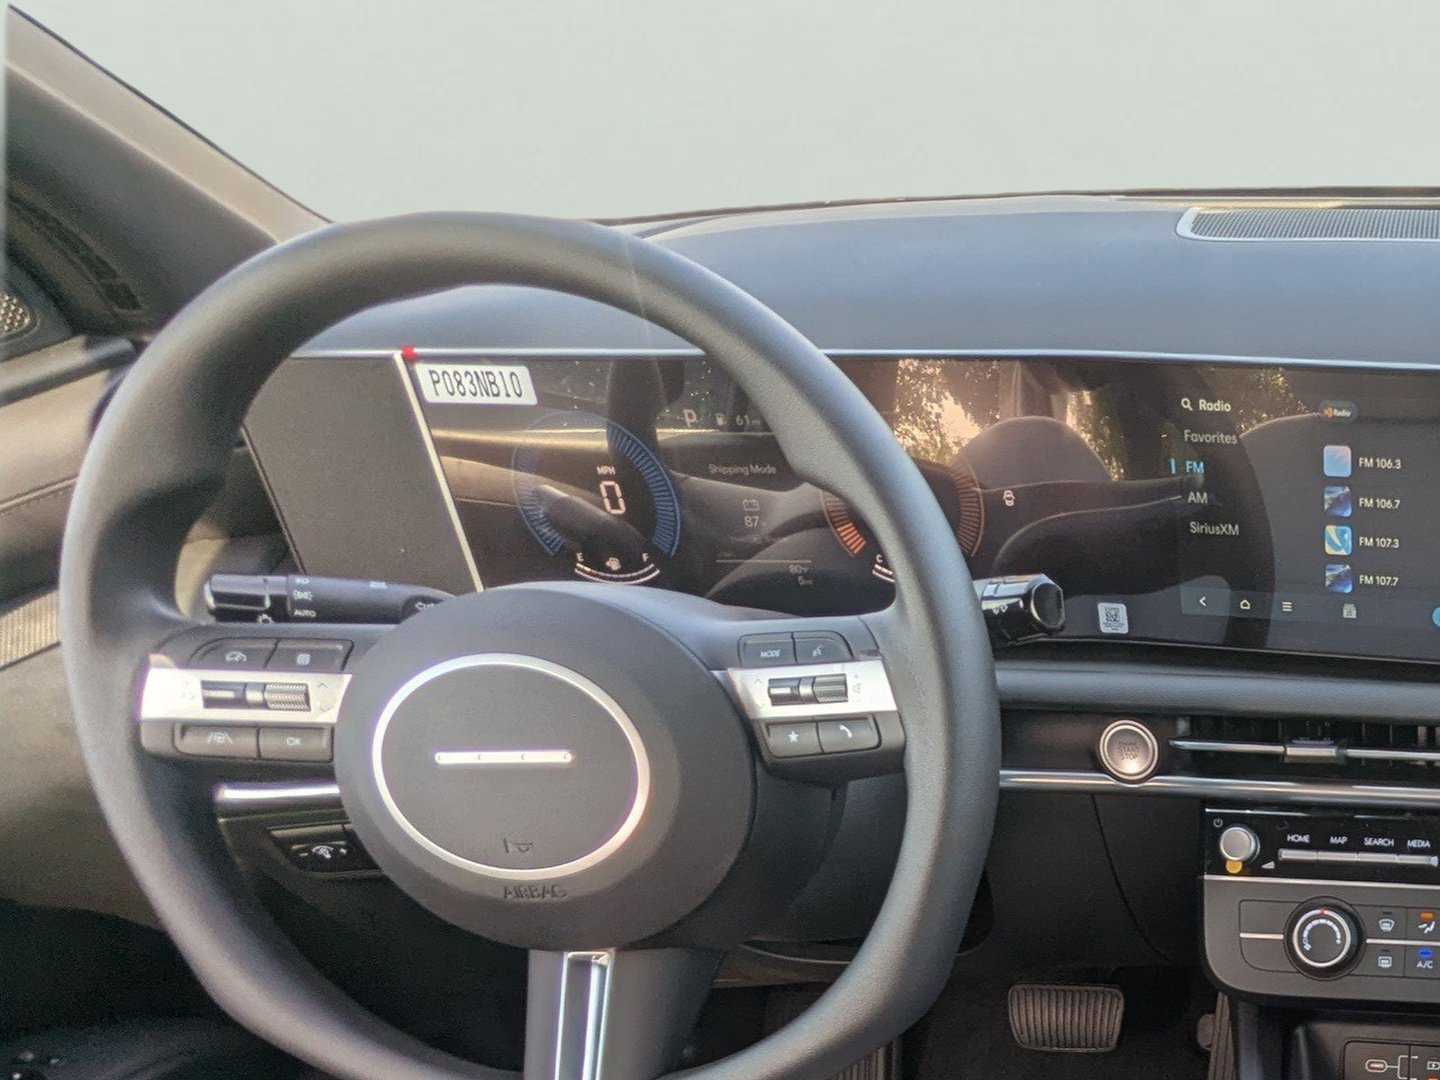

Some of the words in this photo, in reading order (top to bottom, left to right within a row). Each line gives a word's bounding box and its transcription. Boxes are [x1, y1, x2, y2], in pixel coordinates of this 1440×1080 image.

[429, 369, 523, 398] P083NB10
[1199, 399, 1231, 412] Radio
[683, 409, 697, 428] P
[1333, 407, 1351, 418] Radio
[1184, 430, 1238, 445] Favorites
[709, 464, 749, 476] Shipping
[750, 465, 776, 474] Mode
[1185, 461, 1204, 474] FM
[1359, 458, 1374, 469] FM
[1375, 458, 1401, 470] 106.3
[600, 481, 626, 515] 0
[1188, 492, 1208, 504] AM
[1359, 498, 1374, 508] FM
[1375, 499, 1400, 510] 106.7
[744, 515, 759, 527] 87
[1190, 521, 1239, 536] SiriusXM
[1359, 538, 1374, 547] FM
[1375, 538, 1400, 549] 107.3
[577, 553, 584, 562] E
[642, 553, 649, 562] F
[876, 554, 883, 563] C
[1359, 575, 1374, 585] FM
[1375, 576, 1399, 587] 107.7
[293, 609, 317, 618] AUTO
[760, 649, 781, 658] MODE
[1287, 834, 1310, 843] HOME
[1330, 836, 1347, 845] MAP
[1364, 837, 1394, 847] SEARCH
[1407, 839, 1430, 848] MEDIA
[1416, 960, 1433, 969] A/C
